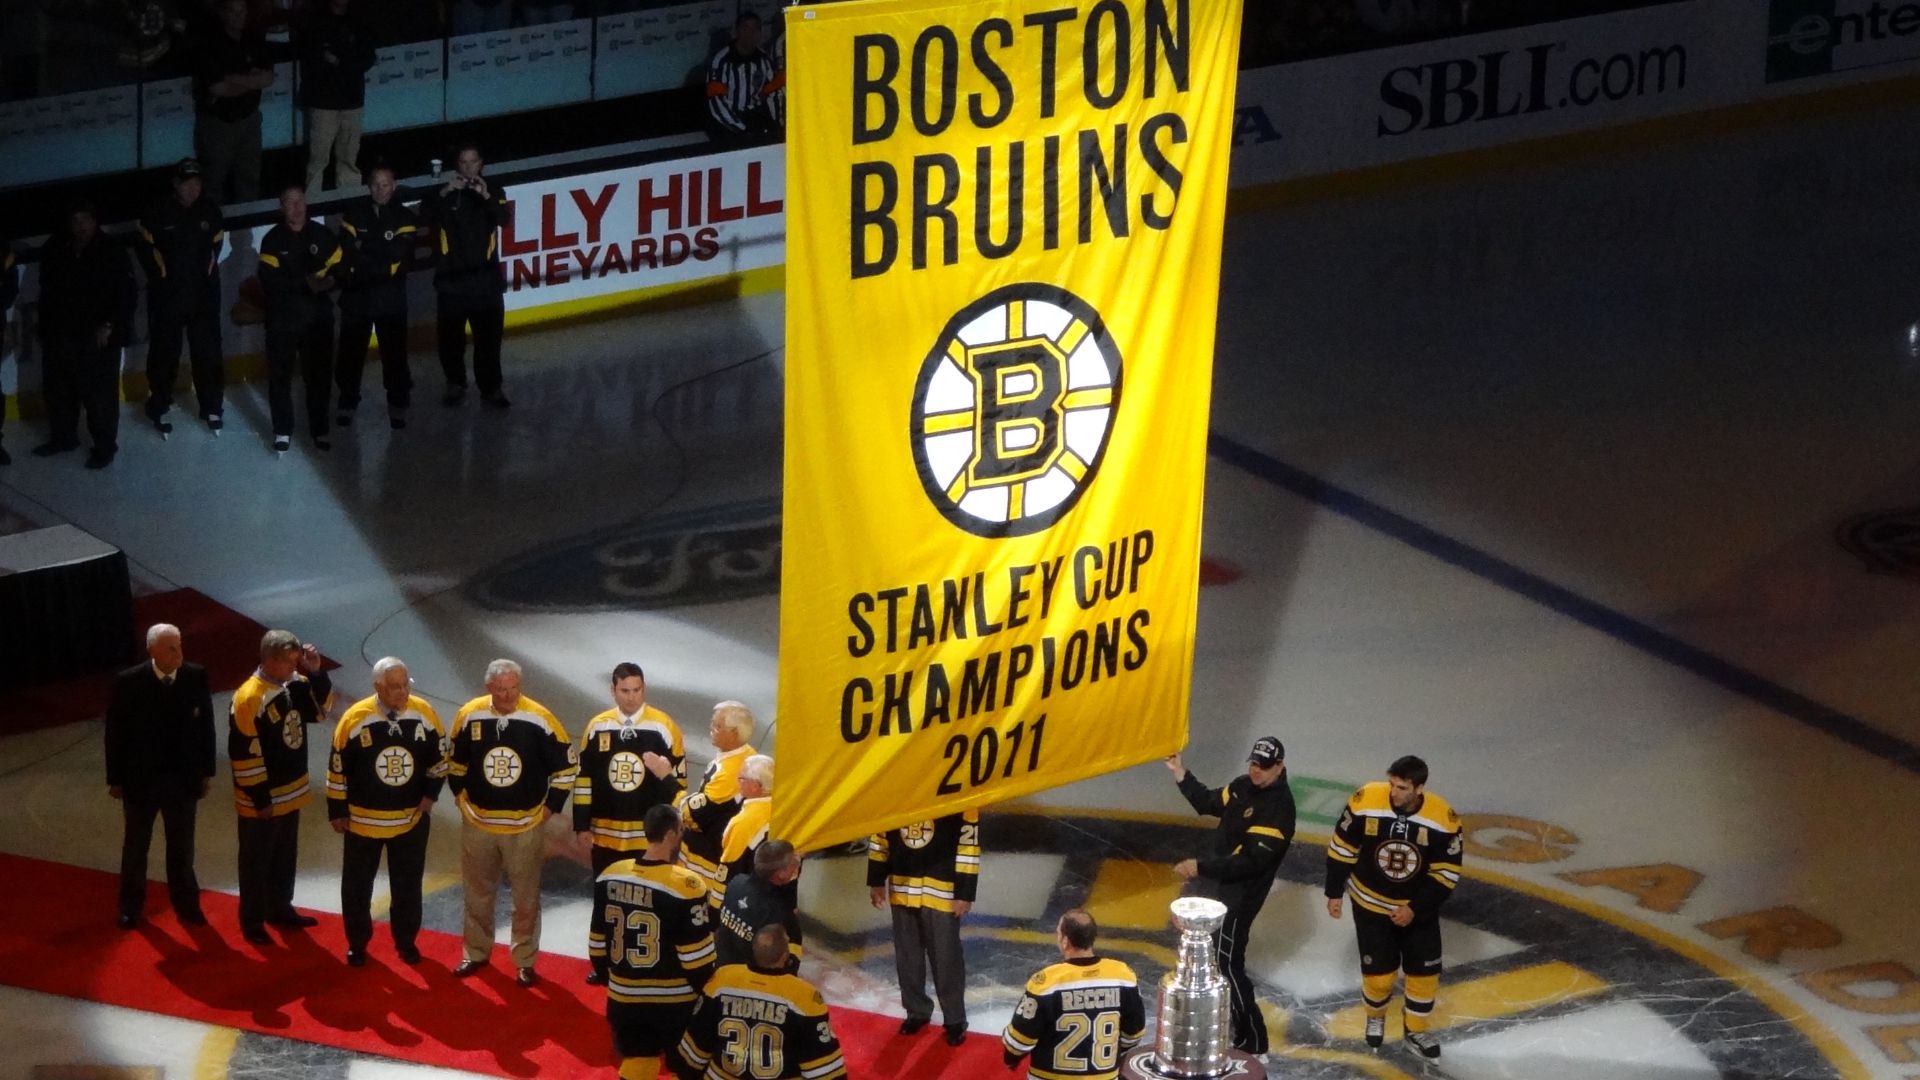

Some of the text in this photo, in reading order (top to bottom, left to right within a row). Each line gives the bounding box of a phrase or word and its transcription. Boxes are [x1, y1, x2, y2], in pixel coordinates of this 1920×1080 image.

[852, 0, 1190, 145] BOSTON
[1377, 43, 1687, 138] SBLI.com
[638, 161, 784, 235] HILL
[851, 112, 1188, 280] BRUINS
[848, 530, 1154, 658] STANLEY CUP
[840, 609, 1150, 743] CHAMPIONS
[937, 713, 1047, 796] 2011
[606, 880, 654, 908] CHARA
[605, 904, 661, 968] 33
[720, 995, 788, 1024] THOMAS
[1061, 987, 1121, 1011] RECCHI
[718, 1017, 784, 1079] 30
[1052, 1010, 1121, 1071] 28
